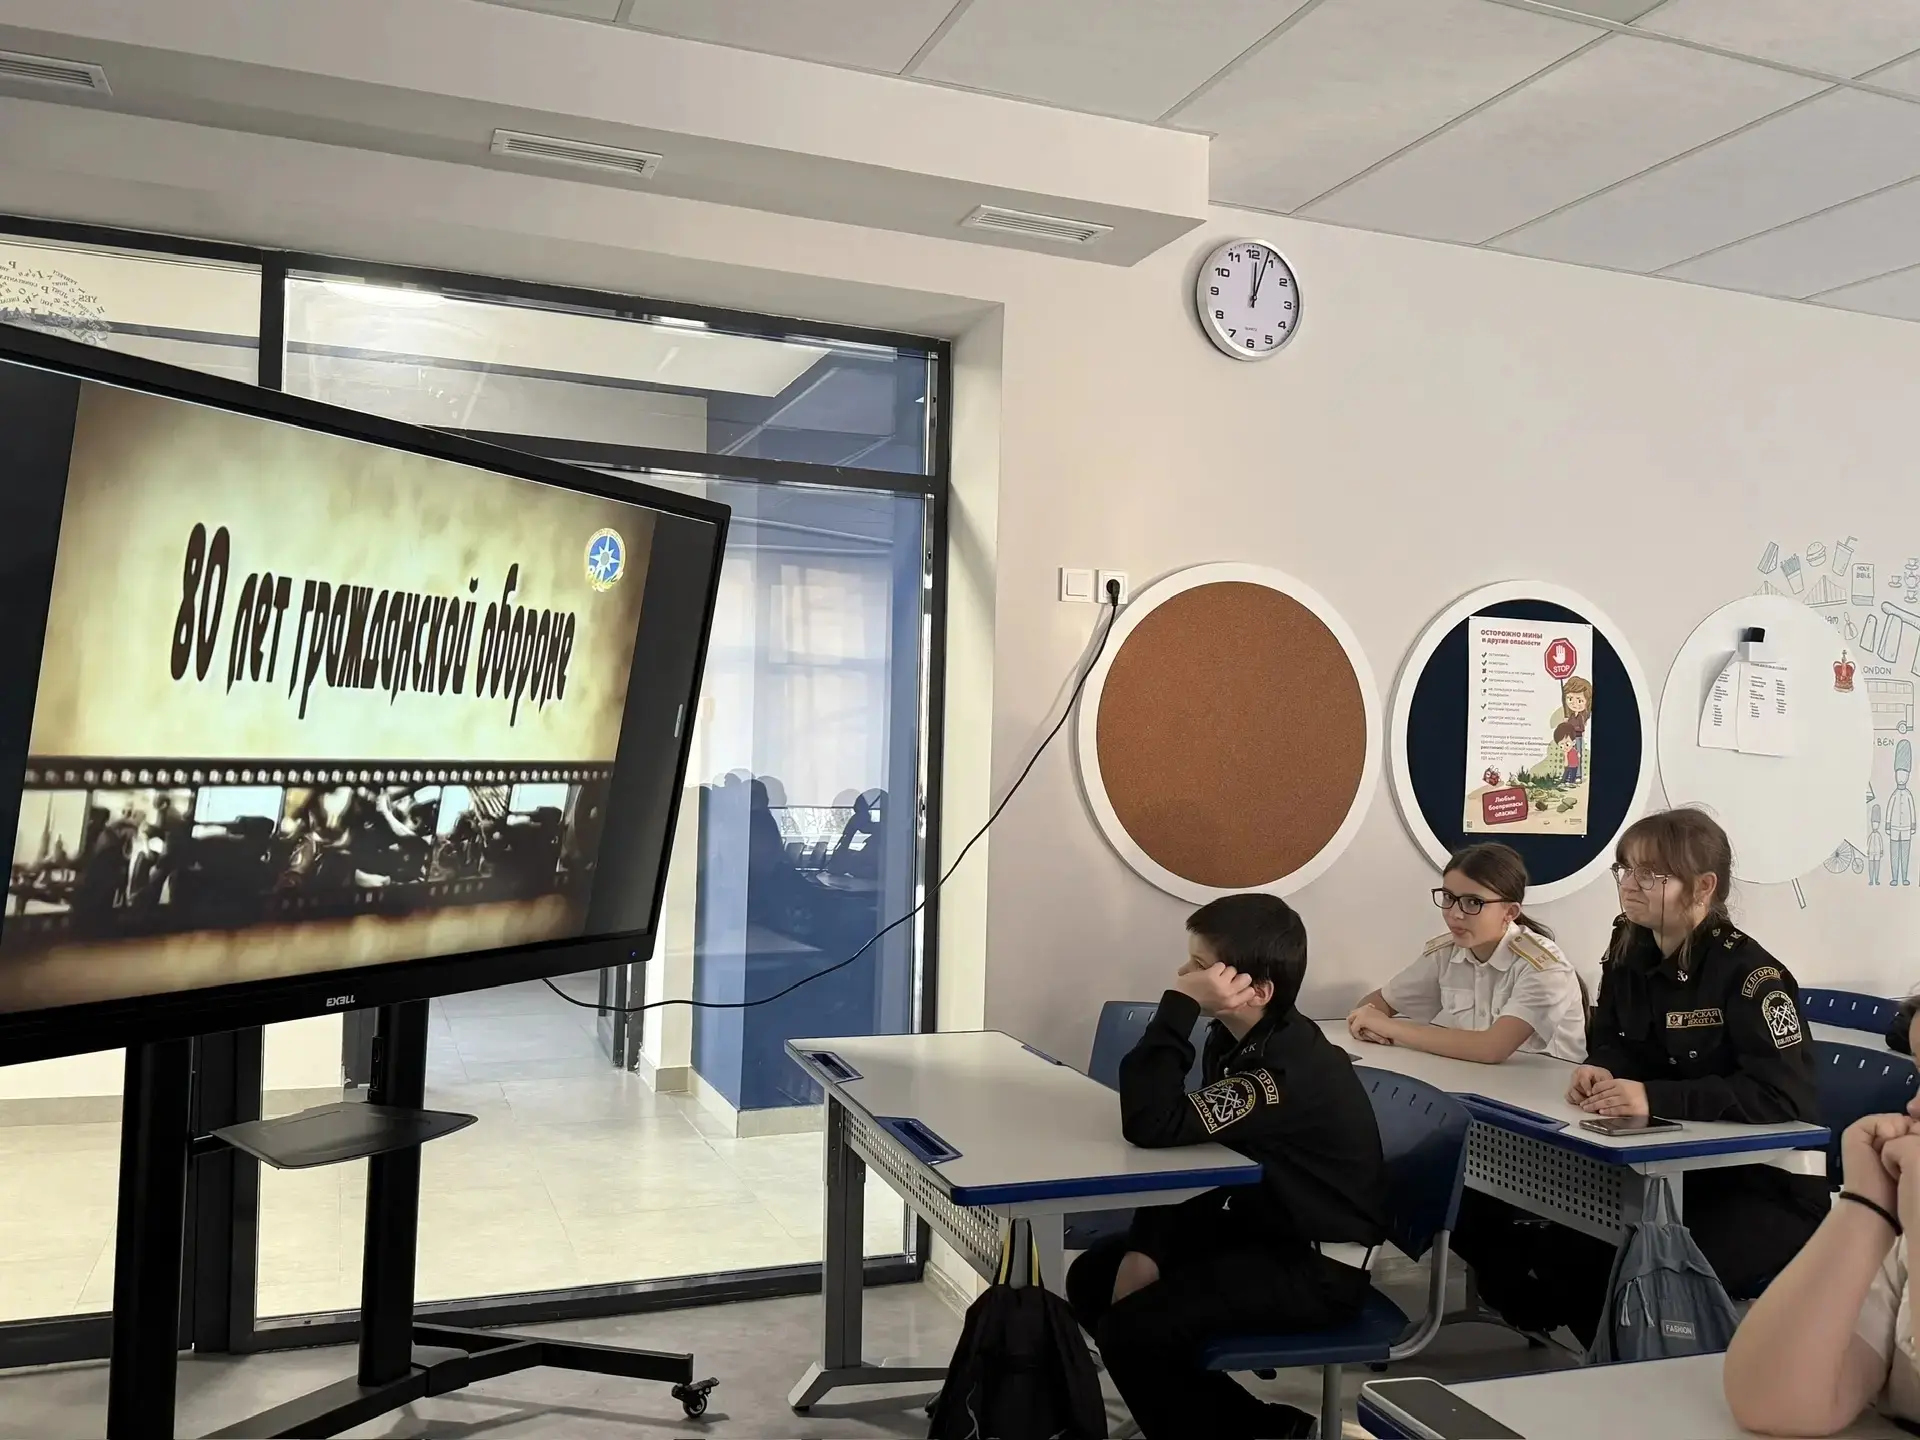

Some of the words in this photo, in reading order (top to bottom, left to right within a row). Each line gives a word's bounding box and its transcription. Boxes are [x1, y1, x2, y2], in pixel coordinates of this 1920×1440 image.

[1228, 252, 1240, 262] 11
[1246, 249, 1260, 260] 12
[1268, 260, 1274, 268] 1
[1215, 267, 1230, 278] 10
[1279, 278, 1288, 287] 2
[1210, 286, 1220, 296] 9
[1284, 301, 1292, 310] 3
[1215, 310, 1224, 320] 8
[1278, 321, 1286, 330] 4
[1228, 328, 1236, 338] 7
[1246, 339, 1254, 348] 6
[1264, 334, 1273, 344] 5
[171, 522, 230, 683] 80
[226, 572, 293, 696] лет
[288, 576, 478, 720] гражданской
[476, 563, 576, 728] обороне
[1480, 630, 1522, 638] ОСТОРОЖНО
[1553, 664, 1570, 673] STOP
[1862, 666, 1892, 675] ONDON
[1877, 738, 1894, 746] BEN
[1666, 1324, 1692, 1336] FASHION
